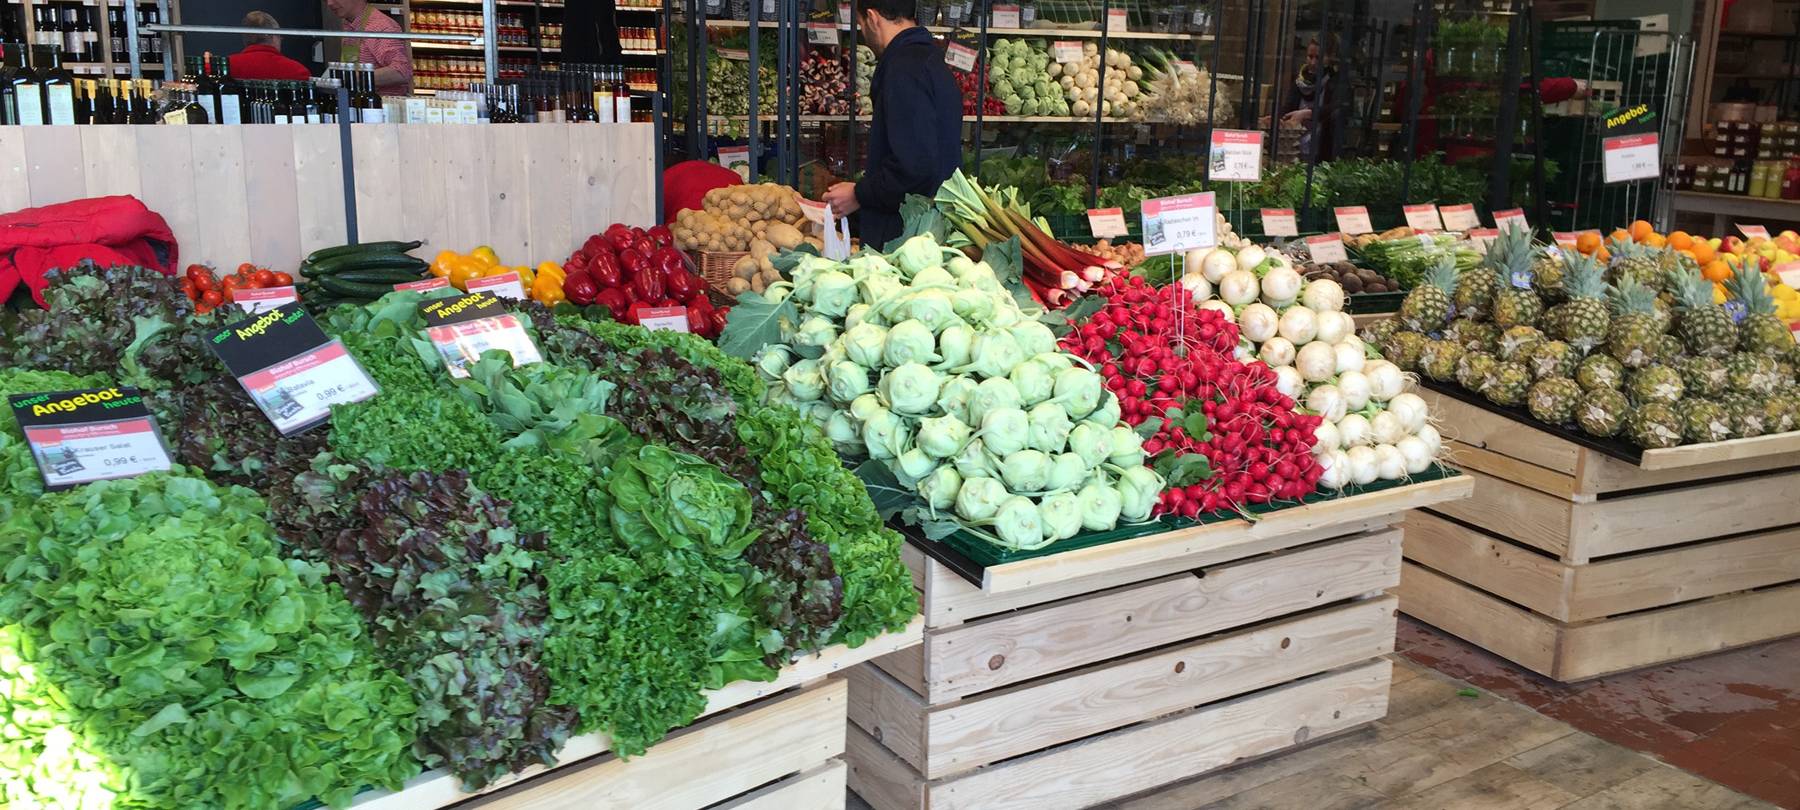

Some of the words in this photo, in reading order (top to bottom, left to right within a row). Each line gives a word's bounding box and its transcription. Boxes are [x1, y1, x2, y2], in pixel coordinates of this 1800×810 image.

[1606, 103, 1649, 129] Angebot
[423, 301, 445, 314] unser
[436, 292, 486, 319] Angebot
[235, 308, 285, 341] Angebot
[212, 329, 232, 344] unser
[14, 393, 50, 408] unser
[316, 387, 337, 401] 0,99
[337, 384, 346, 393] €
[32, 387, 124, 417] Angebot
[103, 457, 128, 468] 0,99
[129, 456, 138, 464] €
